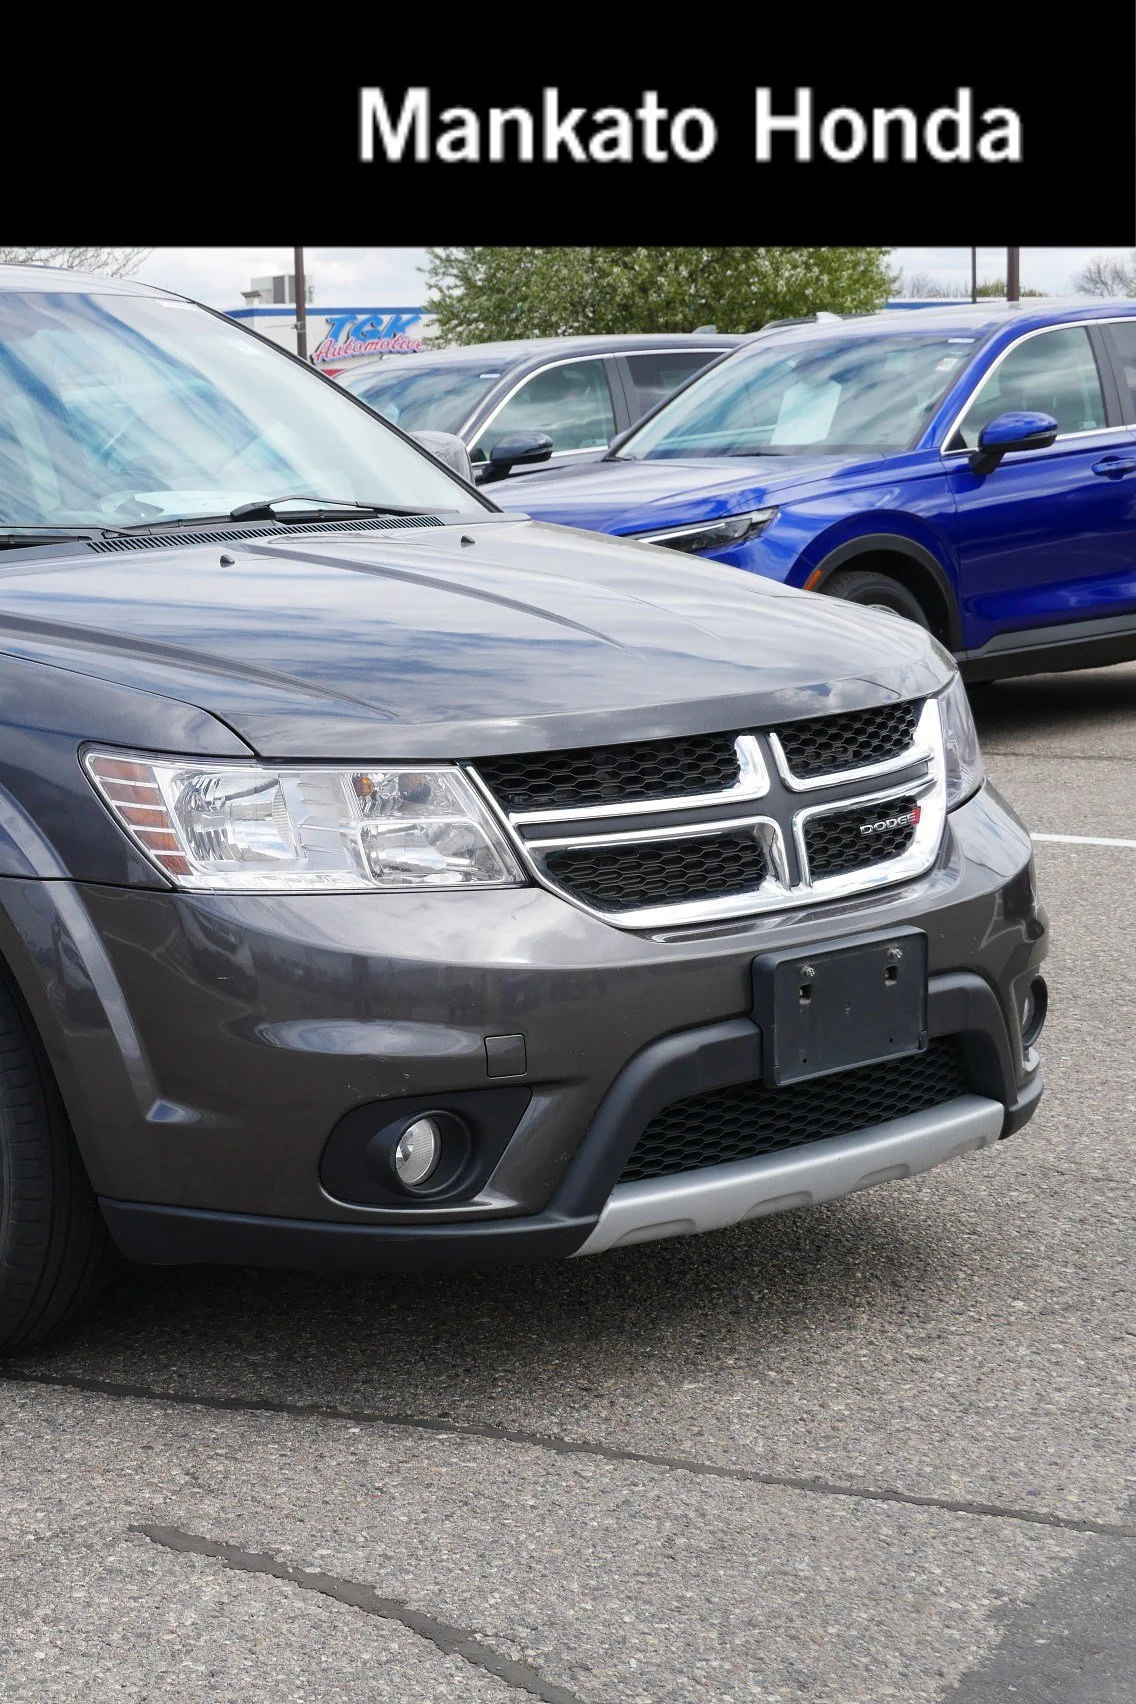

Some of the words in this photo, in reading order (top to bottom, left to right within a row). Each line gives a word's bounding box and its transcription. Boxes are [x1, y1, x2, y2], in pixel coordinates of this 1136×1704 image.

[327, 314, 421, 341] TGK
[315, 334, 425, 362] Automotive
[859, 812, 916, 835] DODGE
